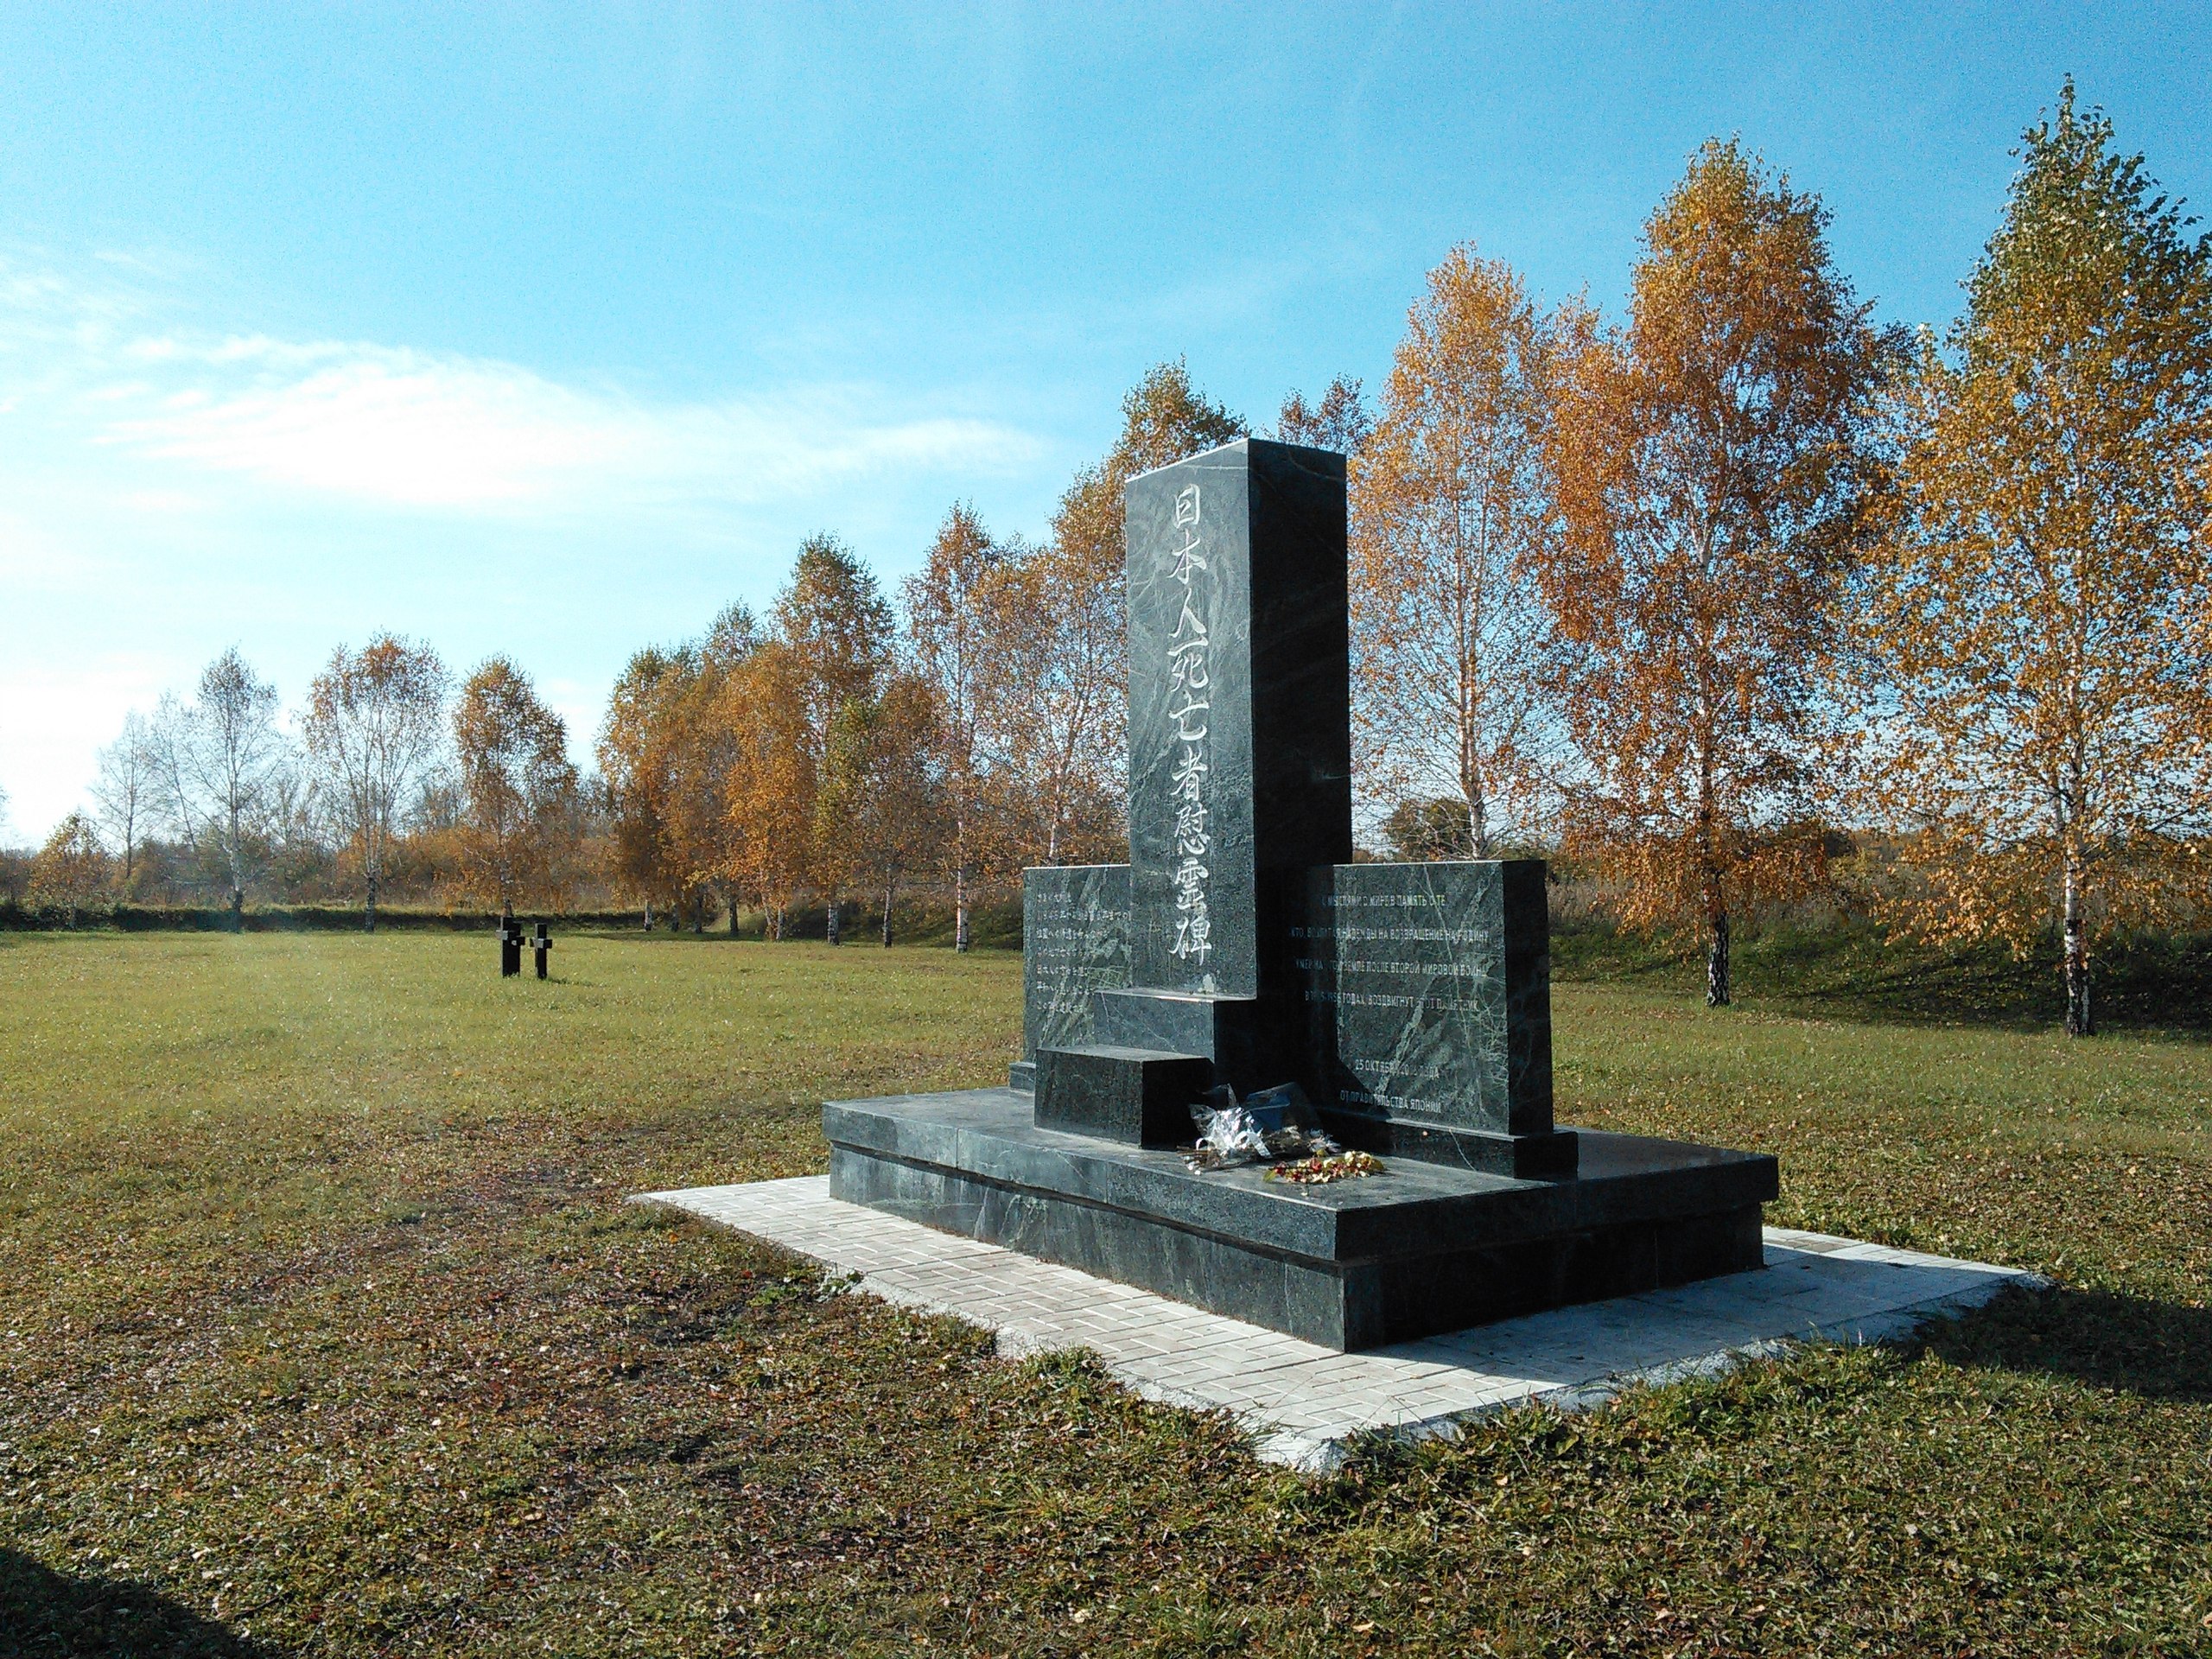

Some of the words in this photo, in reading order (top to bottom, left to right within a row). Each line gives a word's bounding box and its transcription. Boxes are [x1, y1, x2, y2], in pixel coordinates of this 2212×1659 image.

[1167, 484, 1212, 966] 日本人死亡者慰霊碑
[1396, 894, 1427, 906] ПАМЯТЬ
[1368, 995, 1414, 1008] ВОЗДВИГНУТ
[1355, 1058, 1364, 1071] 25
